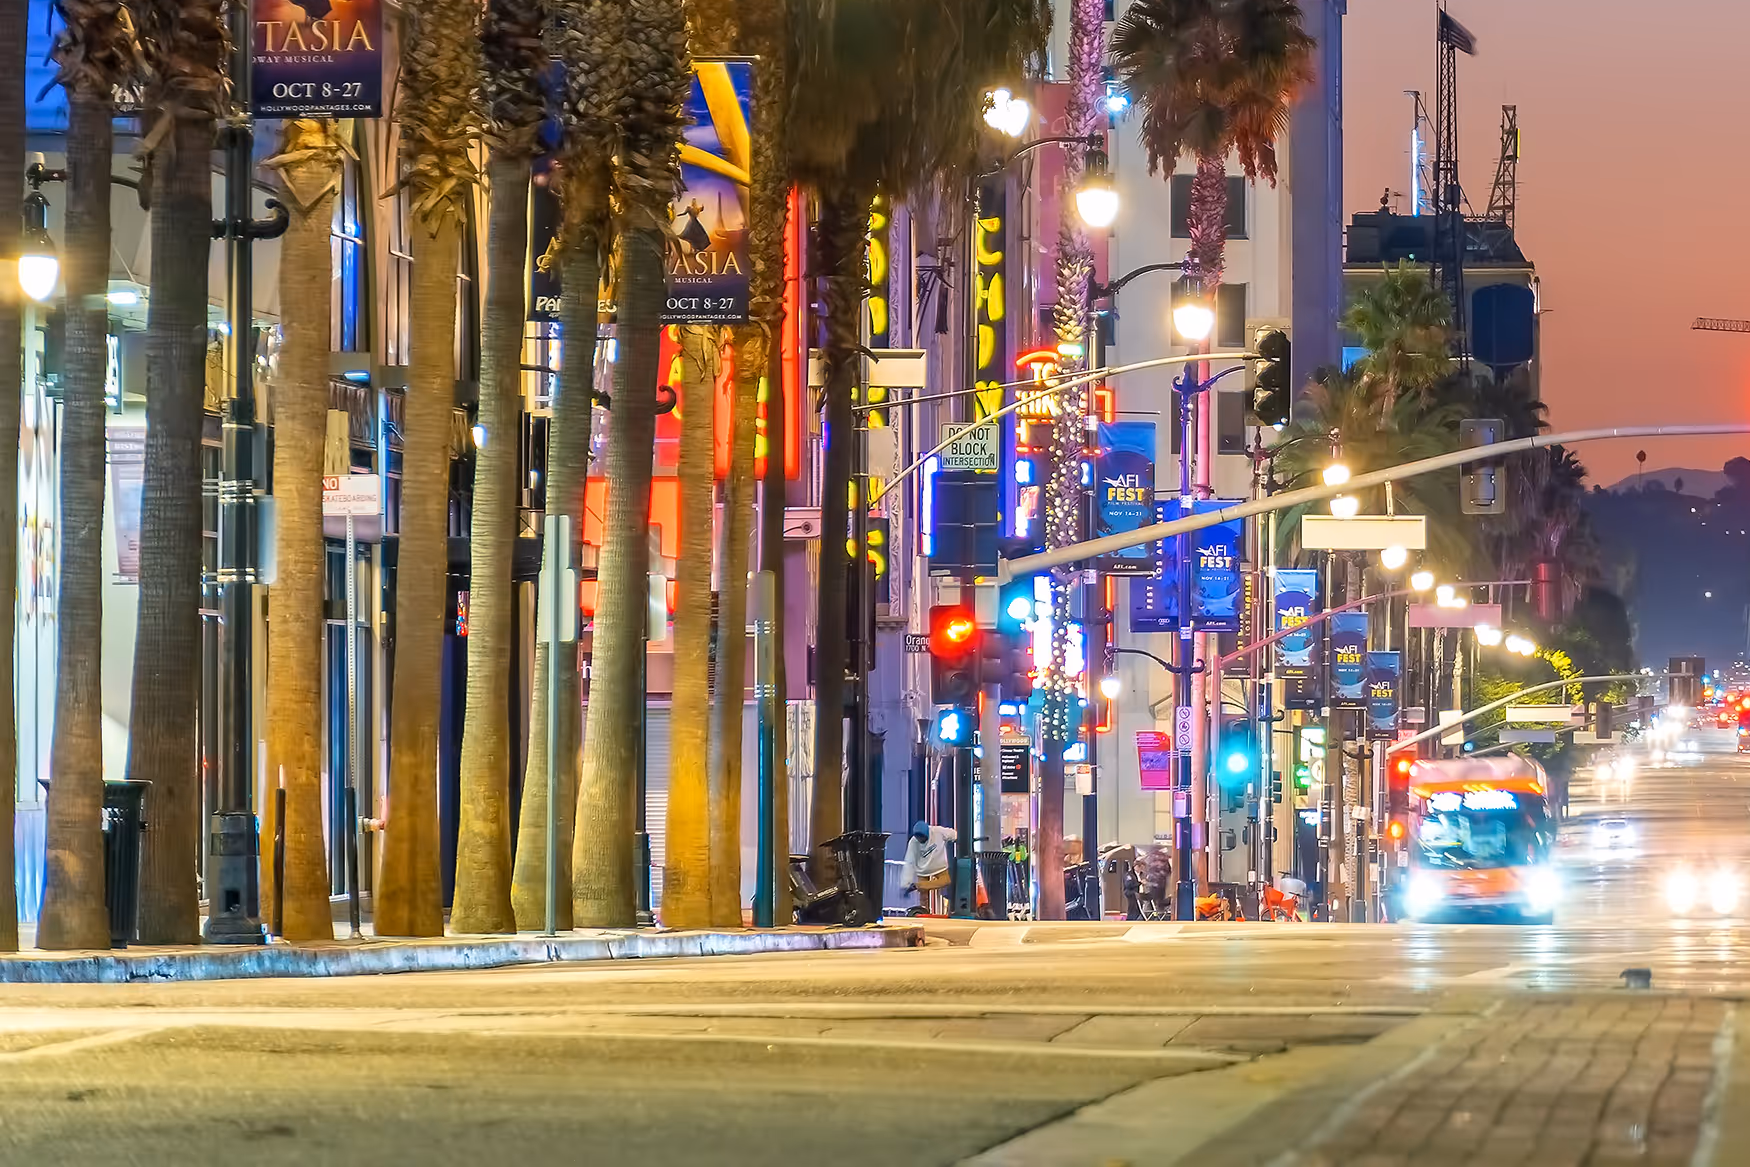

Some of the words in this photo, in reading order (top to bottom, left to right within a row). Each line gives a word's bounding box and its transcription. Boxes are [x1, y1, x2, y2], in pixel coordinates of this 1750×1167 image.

[256, 19, 376, 52] TASIA
[285, 55, 334, 63] MUSICAL
[272, 82, 317, 99] OCT
[321, 82, 362, 99] 8-27
[669, 251, 744, 275] ASIA
[666, 297, 699, 310] OCT
[703, 297, 734, 310] 8-27
[969, 427, 990, 440] NOT
[951, 442, 987, 455] BLOCK
[943, 456, 995, 466] INTERSECTION
[322, 477, 338, 490] NO
[1114, 474, 1139, 488] AFI
[1107, 487, 1145, 502] FEST
[1205, 544, 1227, 557] AFI
[1200, 557, 1232, 568] FEST
[1337, 654, 1361, 663] FEST
[1371, 689, 1393, 698] FEST
